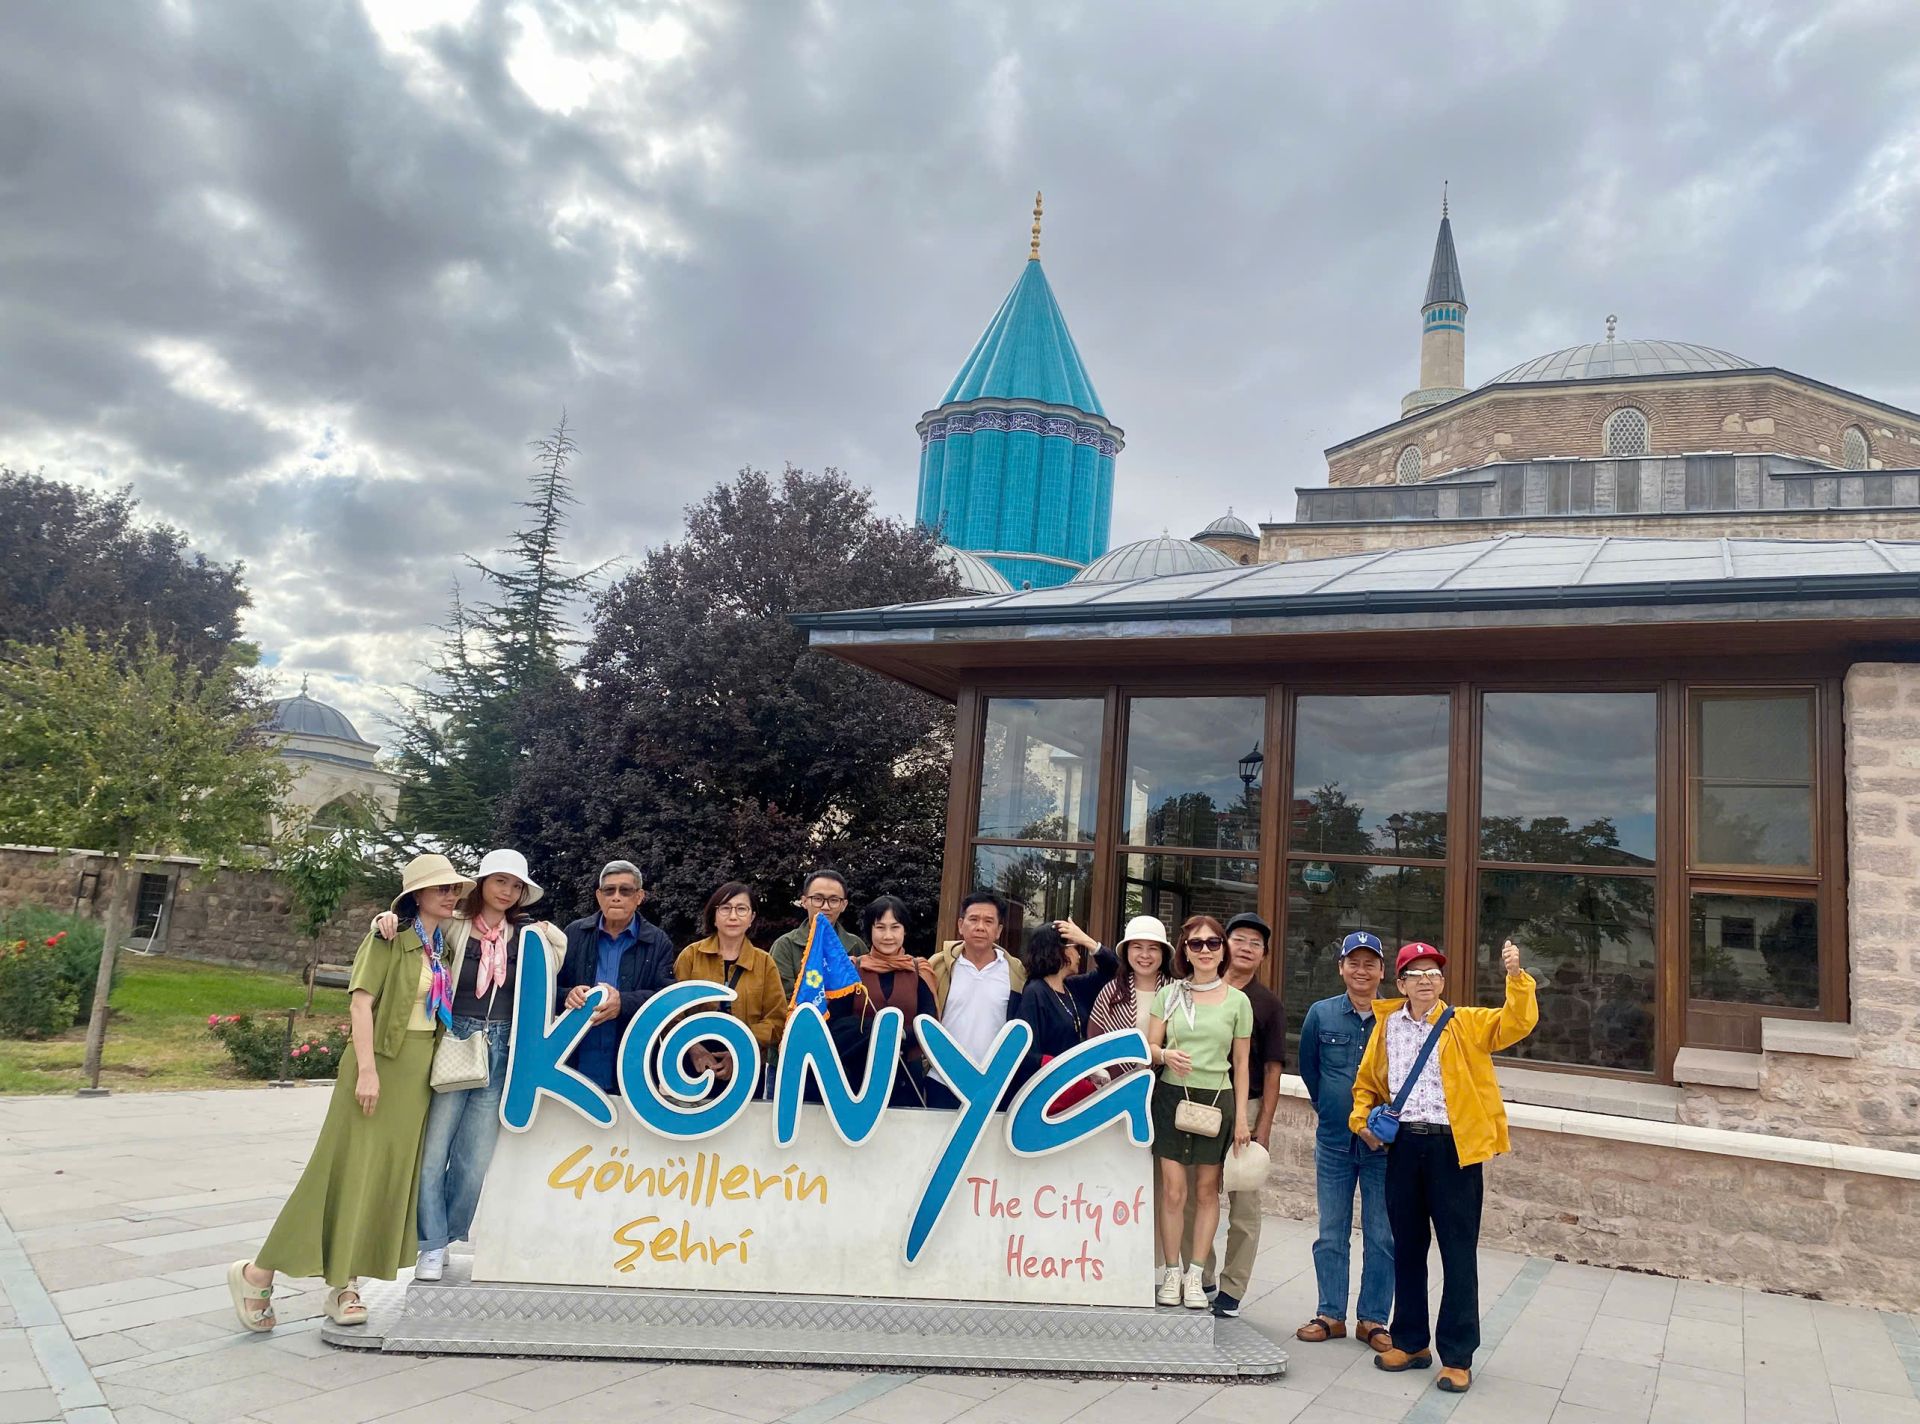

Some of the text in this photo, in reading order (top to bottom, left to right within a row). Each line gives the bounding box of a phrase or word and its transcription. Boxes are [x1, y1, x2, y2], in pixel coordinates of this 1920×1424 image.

[967, 1176, 1146, 1242] The City of
[613, 1216, 754, 1273] Şehri
[1006, 1234, 1105, 1282] Hearts
